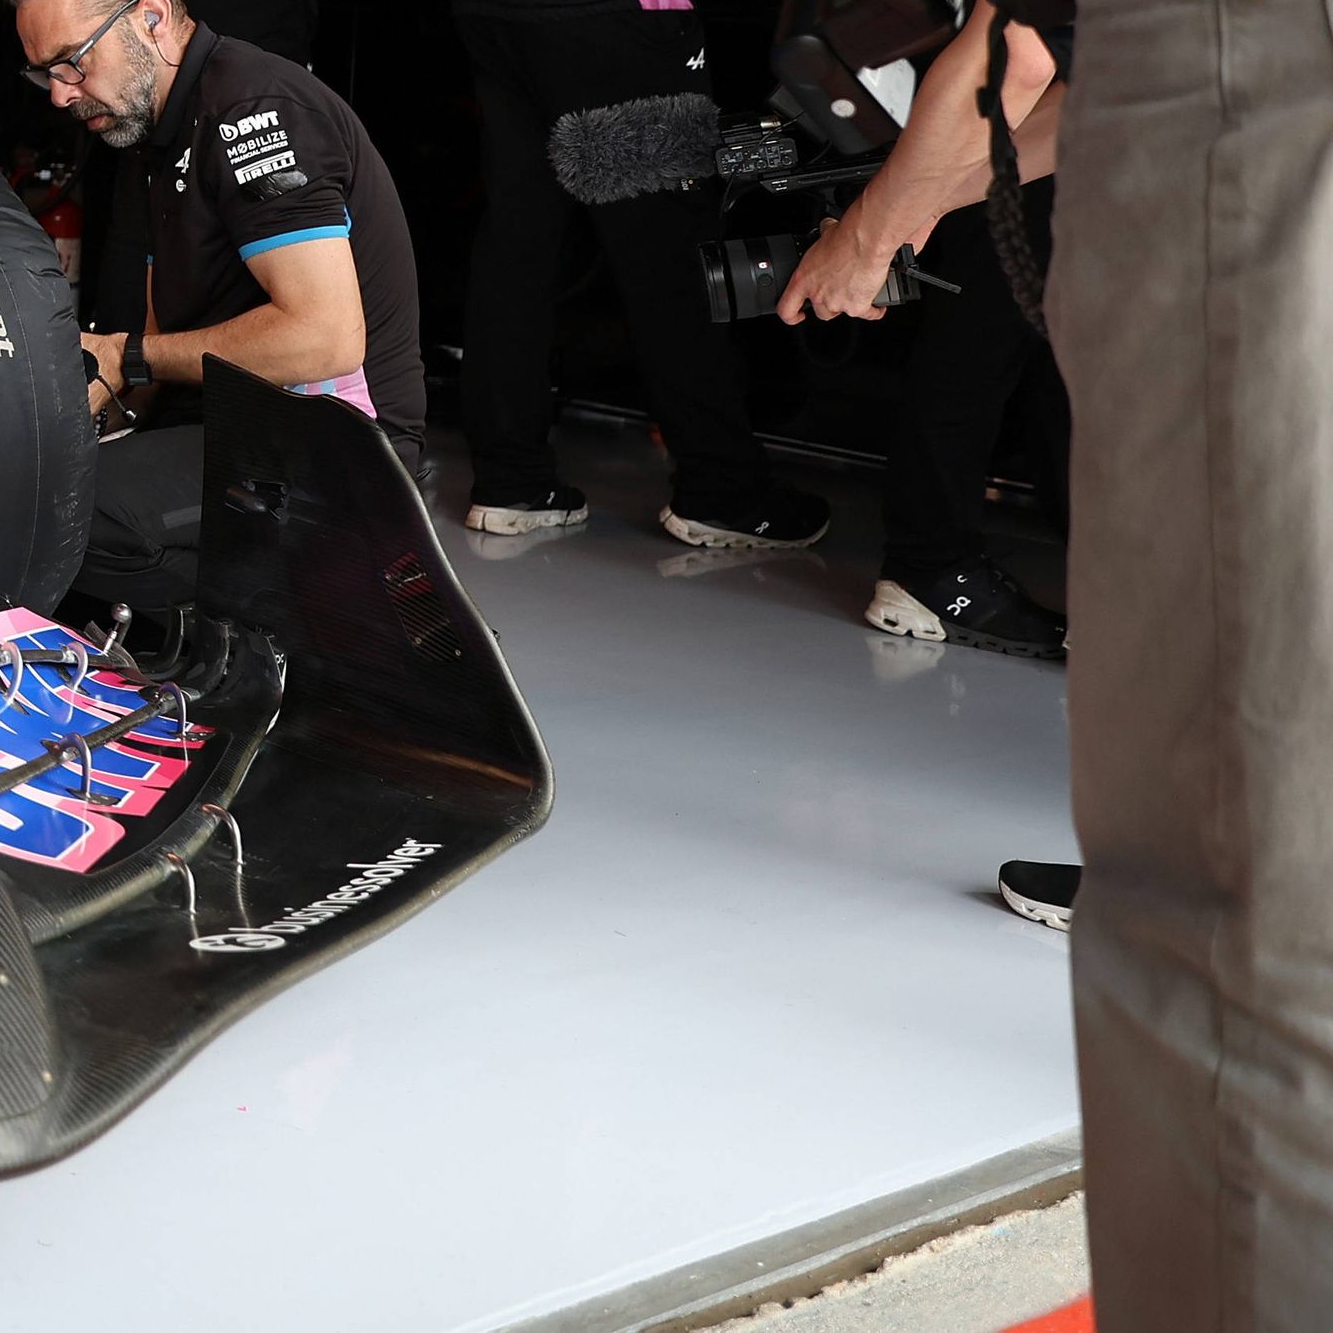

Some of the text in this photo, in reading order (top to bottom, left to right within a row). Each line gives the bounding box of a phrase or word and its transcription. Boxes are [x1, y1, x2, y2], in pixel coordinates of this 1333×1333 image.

[237, 110, 280, 136] BWT
[234, 150, 296, 185] PIRELLI
[269, 837, 443, 934] businessolver
